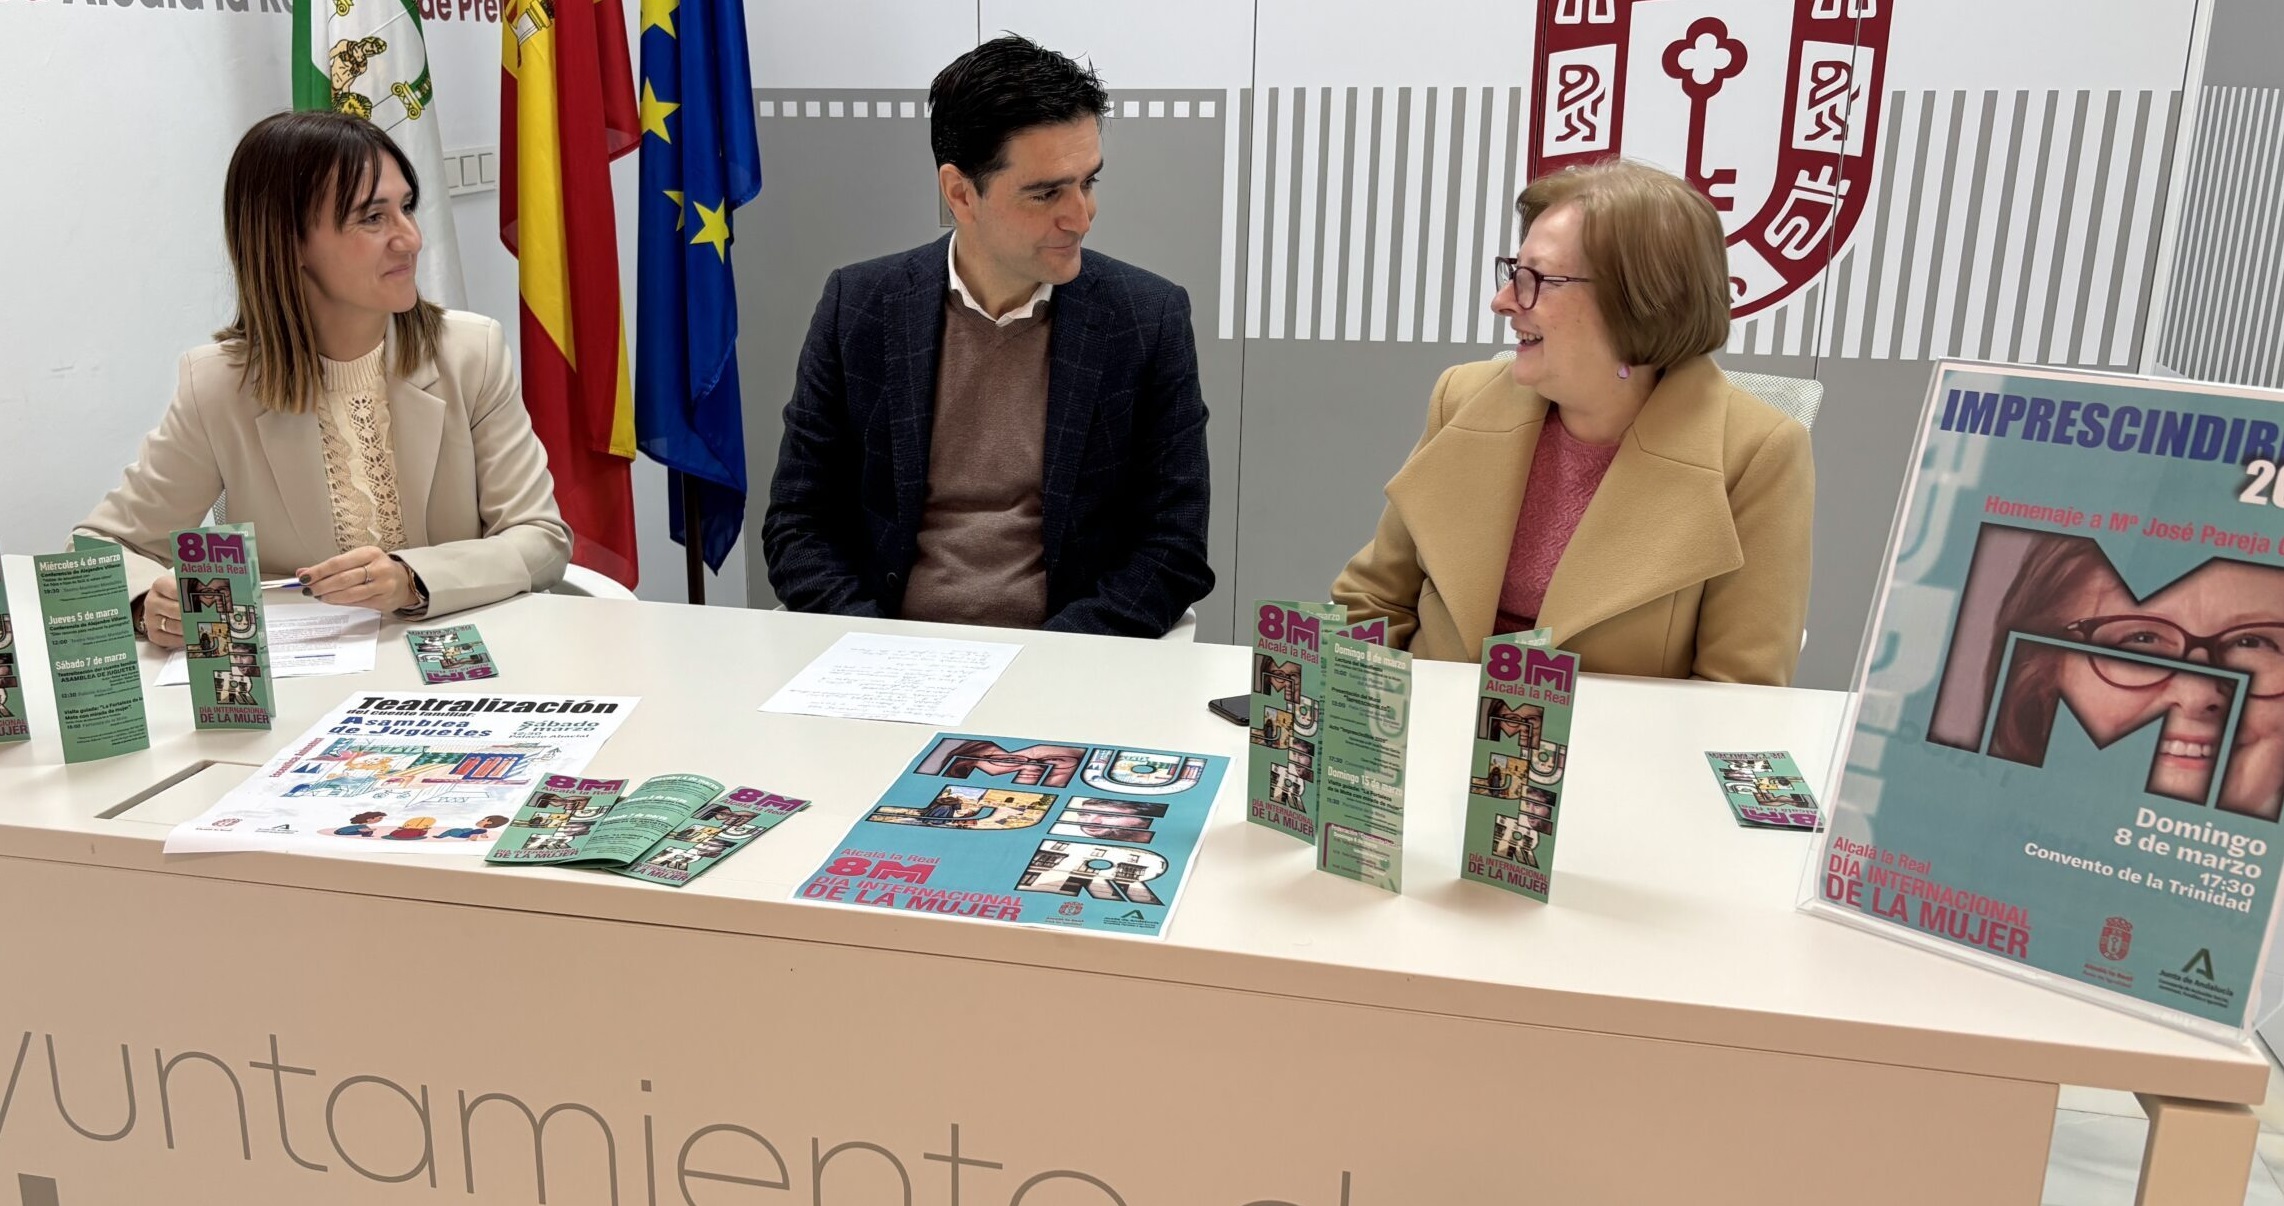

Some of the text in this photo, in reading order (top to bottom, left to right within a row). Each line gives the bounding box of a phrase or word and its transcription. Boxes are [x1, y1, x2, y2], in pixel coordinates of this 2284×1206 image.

[458, 0, 504, 23] Pre
[1985, 495, 2086, 527] Homenaje
[2090, 515, 2101, 529] a
[2143, 518, 2195, 542] José
[2200, 525, 2270, 555] Pareja
[177, 532, 246, 564] 8M
[39, 553, 121, 571] Miércoles 4 de marzo
[181, 563, 247, 574] Alcalá la Real
[48, 608, 119, 625] Jueves 5 de marzo
[1257, 604, 1320, 652] 8M
[55, 653, 127, 670] Sábado 7 de marzo
[1257, 638, 1319, 664] Alcalá la Real
[1334, 643, 1365, 660] Domingo
[1372, 652, 1382, 663] de
[1383, 657, 1406, 669] marzo
[1486, 643, 1575, 693] 8M
[357, 697, 618, 713] Teatralización
[1485, 680, 1570, 706] Alcalá la Real
[200, 713, 270, 724] DE LA MUJER
[214, 706, 267, 715] INTERNACIONAL
[340, 716, 470, 727] Asamblea
[329, 726, 361, 734] de
[369, 726, 493, 737] Juguetes
[541, 786, 576, 795] Alcalá
[545, 775, 624, 791] 8M
[1327, 766, 1403, 796] Domingo 15 de marzo
[728, 788, 807, 811] 8M
[764, 807, 790, 816] Real
[1252, 806, 1314, 837] DE LA MUJER
[2135, 807, 2267, 858] Domingo
[534, 851, 578, 859] MUJER
[841, 848, 941, 864] Alcalá la Real
[1833, 836, 1932, 876] Alcalá la Real
[2114, 827, 2262, 879] 8 de marzo
[648, 868, 689, 882] MUJER
[825, 857, 936, 884] 8M
[1468, 853, 1548, 882] DÍA INTERNACIONAL
[1468, 862, 1549, 895] DE LA MUJER
[2024, 842, 2252, 914] Convento de la Trinidad
[814, 875, 1024, 907] DÍA INTERNACIONAL
[1828, 854, 2032, 930] DÍA INTERNACIONAL
[2200, 872, 2255, 898] 17:30
[803, 884, 1023, 921] DE LA MUJER
[1825, 873, 2030, 959] DE LA MUJER
[2158, 969, 2181, 982] Junta
[2182, 975, 2194, 985] de
[2194, 978, 2234, 997] Andalucía
